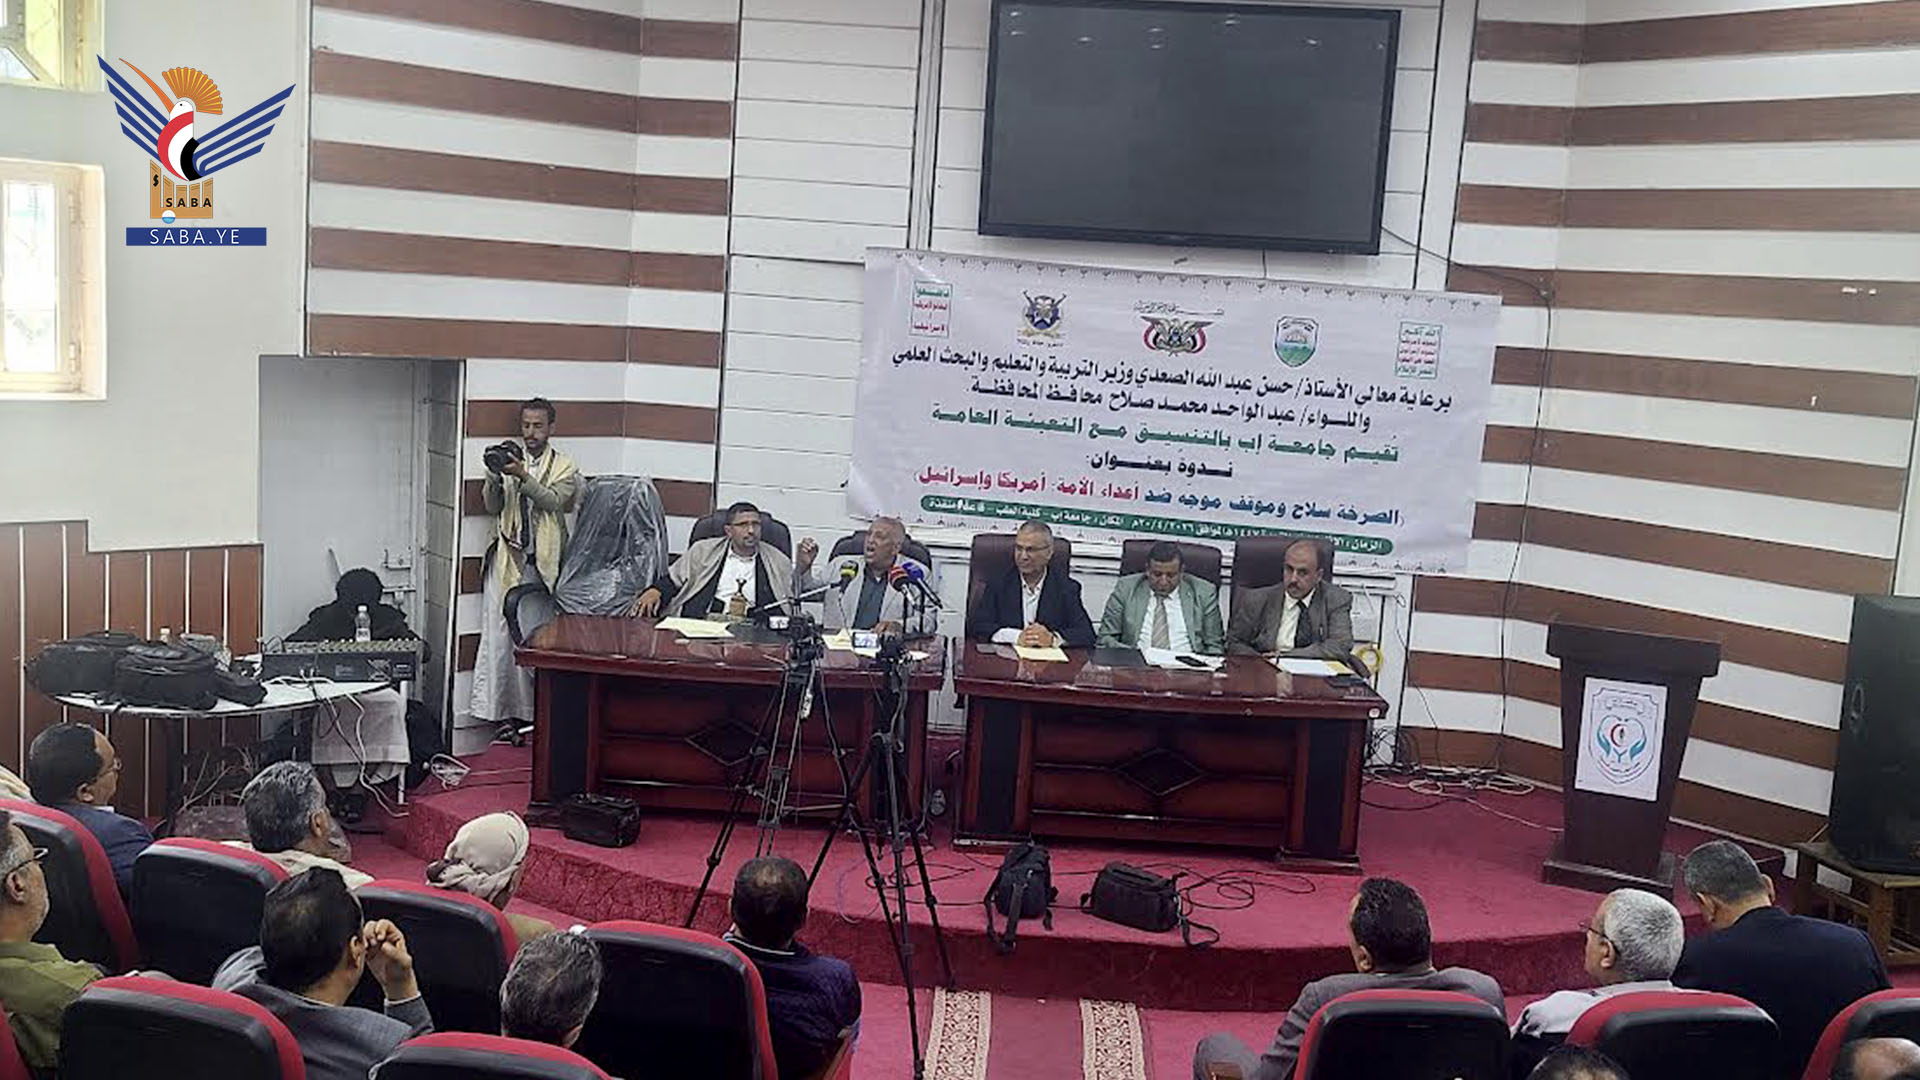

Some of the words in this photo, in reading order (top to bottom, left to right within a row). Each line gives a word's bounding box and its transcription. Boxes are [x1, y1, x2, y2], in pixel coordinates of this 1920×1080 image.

[892, 345, 938, 367] العلمي
[939, 345, 988, 372] والبحث
[992, 351, 1047, 377] والتعليم
[1048, 354, 1098, 380] التربية
[1098, 363, 1133, 385] وزير
[1136, 368, 1194, 388] الصعدي
[1199, 366, 1222, 387] الله
[1224, 376, 1252, 394] عبد
[1046, 378, 1102, 404] محافظ
[1256, 374, 1293, 397] حسن
[1355, 384, 1397, 406] معالي
[1108, 391, 1154, 411] صلاح
[1157, 397, 1208, 414] محمد
[1400, 387, 1453, 413] برعاية
[931, 402, 998, 426] العامة
[1211, 402, 1265, 424] الواحد
[1267, 408, 1296, 427] عبد
[1087, 421, 1127, 440] مع
[1134, 422, 1232, 452] بالتنسيق
[1238, 433, 1262, 455] إب
[1267, 433, 1336, 460] جامعة
[996, 471, 1046, 492] أمريكا
[1100, 480, 1139, 500] أعداء
[1144, 487, 1172, 504] ضد
[1229, 495, 1287, 518] وموقف
[1291, 501, 1331, 520] سلاح
